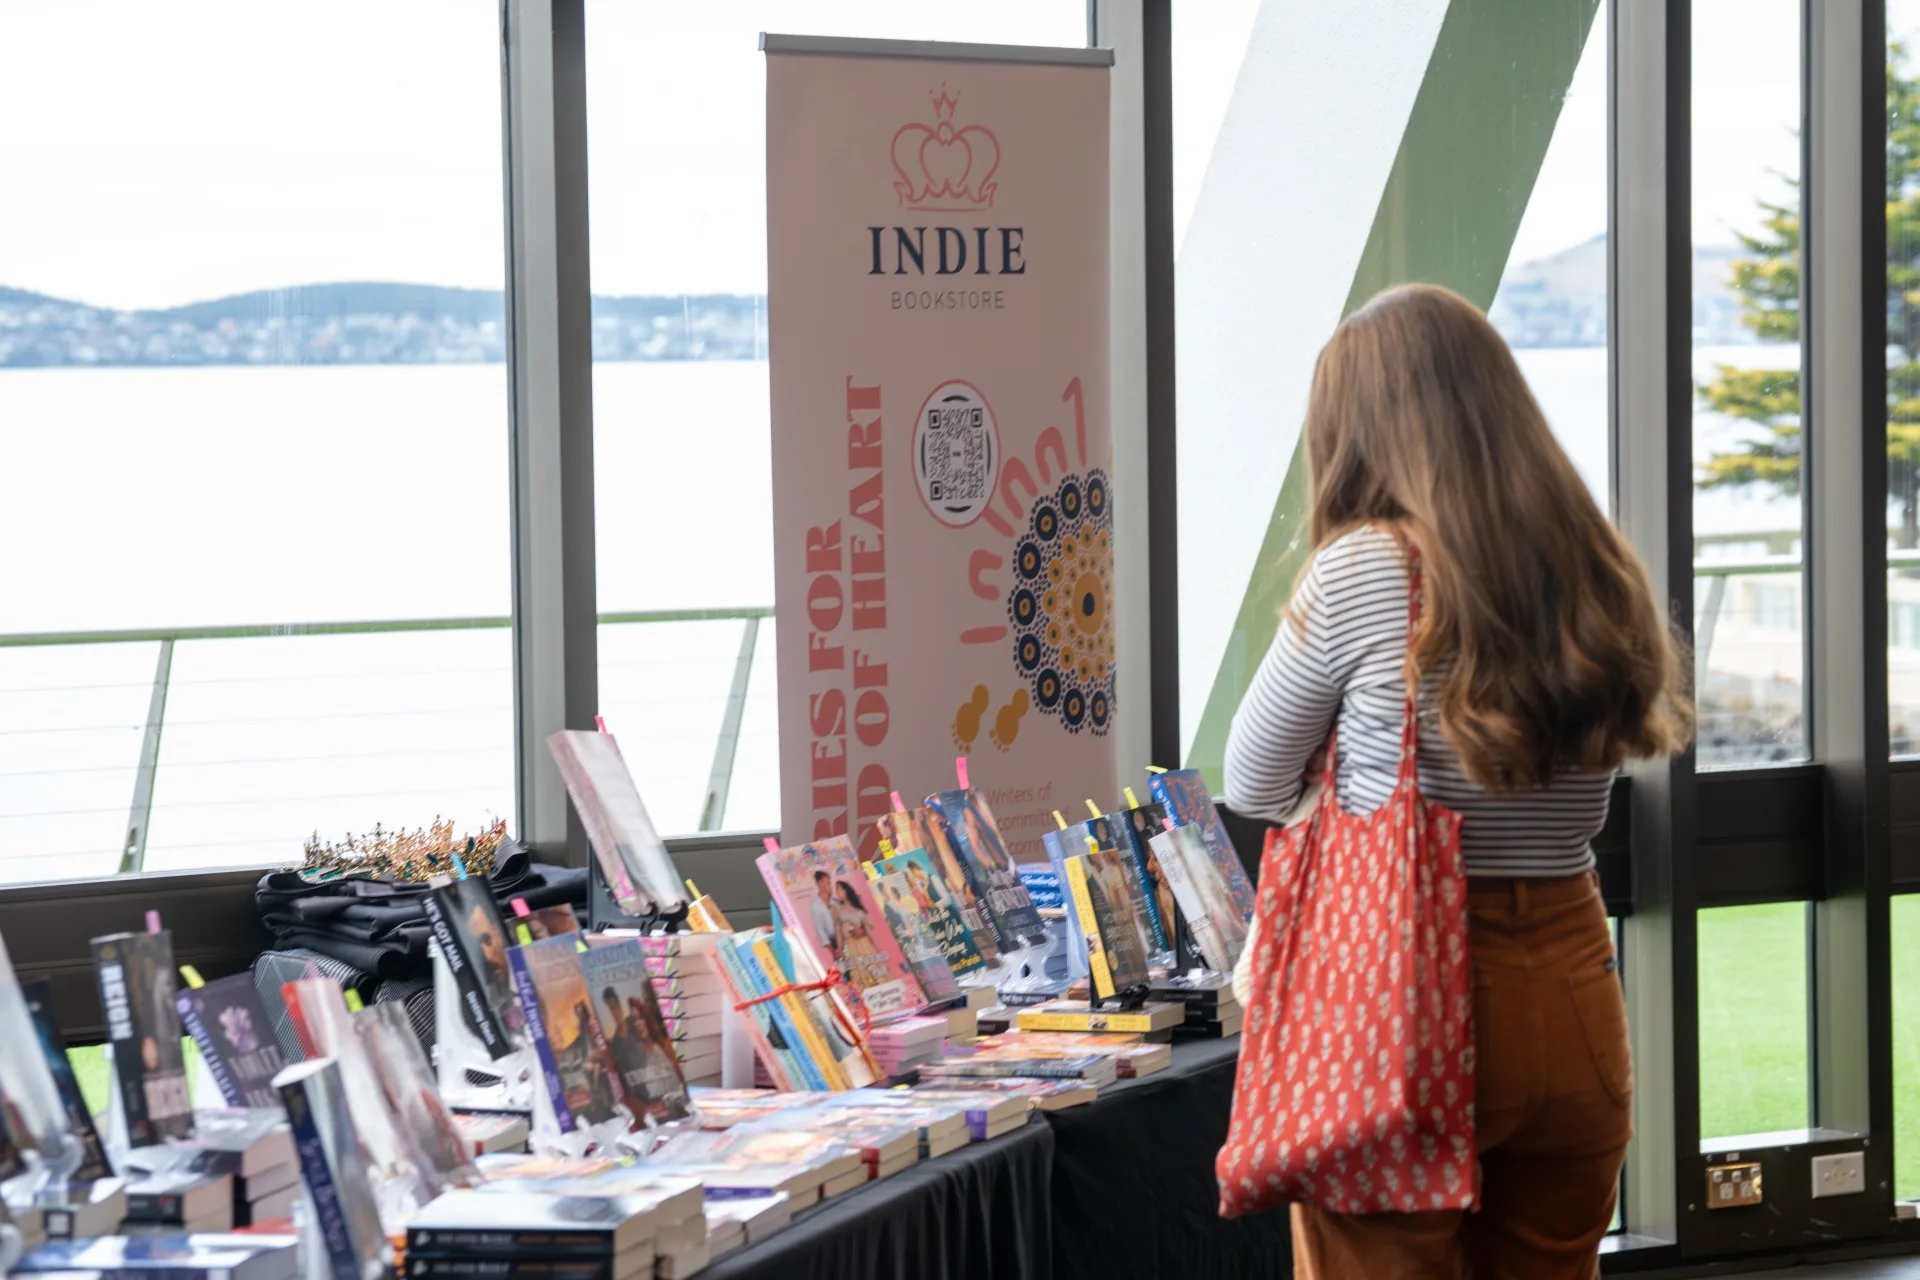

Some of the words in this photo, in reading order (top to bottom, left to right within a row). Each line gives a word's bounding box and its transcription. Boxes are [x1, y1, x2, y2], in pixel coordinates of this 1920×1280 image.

[867, 226, 1027, 275] INDIE
[891, 291, 1005, 310] BOOKSTORE
[846, 374, 887, 632] HEART
[806, 518, 845, 673] FOR
[853, 648, 890, 747] OF
[1037, 781, 1052, 800] of
[996, 804, 1069, 831] committd
[443, 943, 465, 972] MAIL
